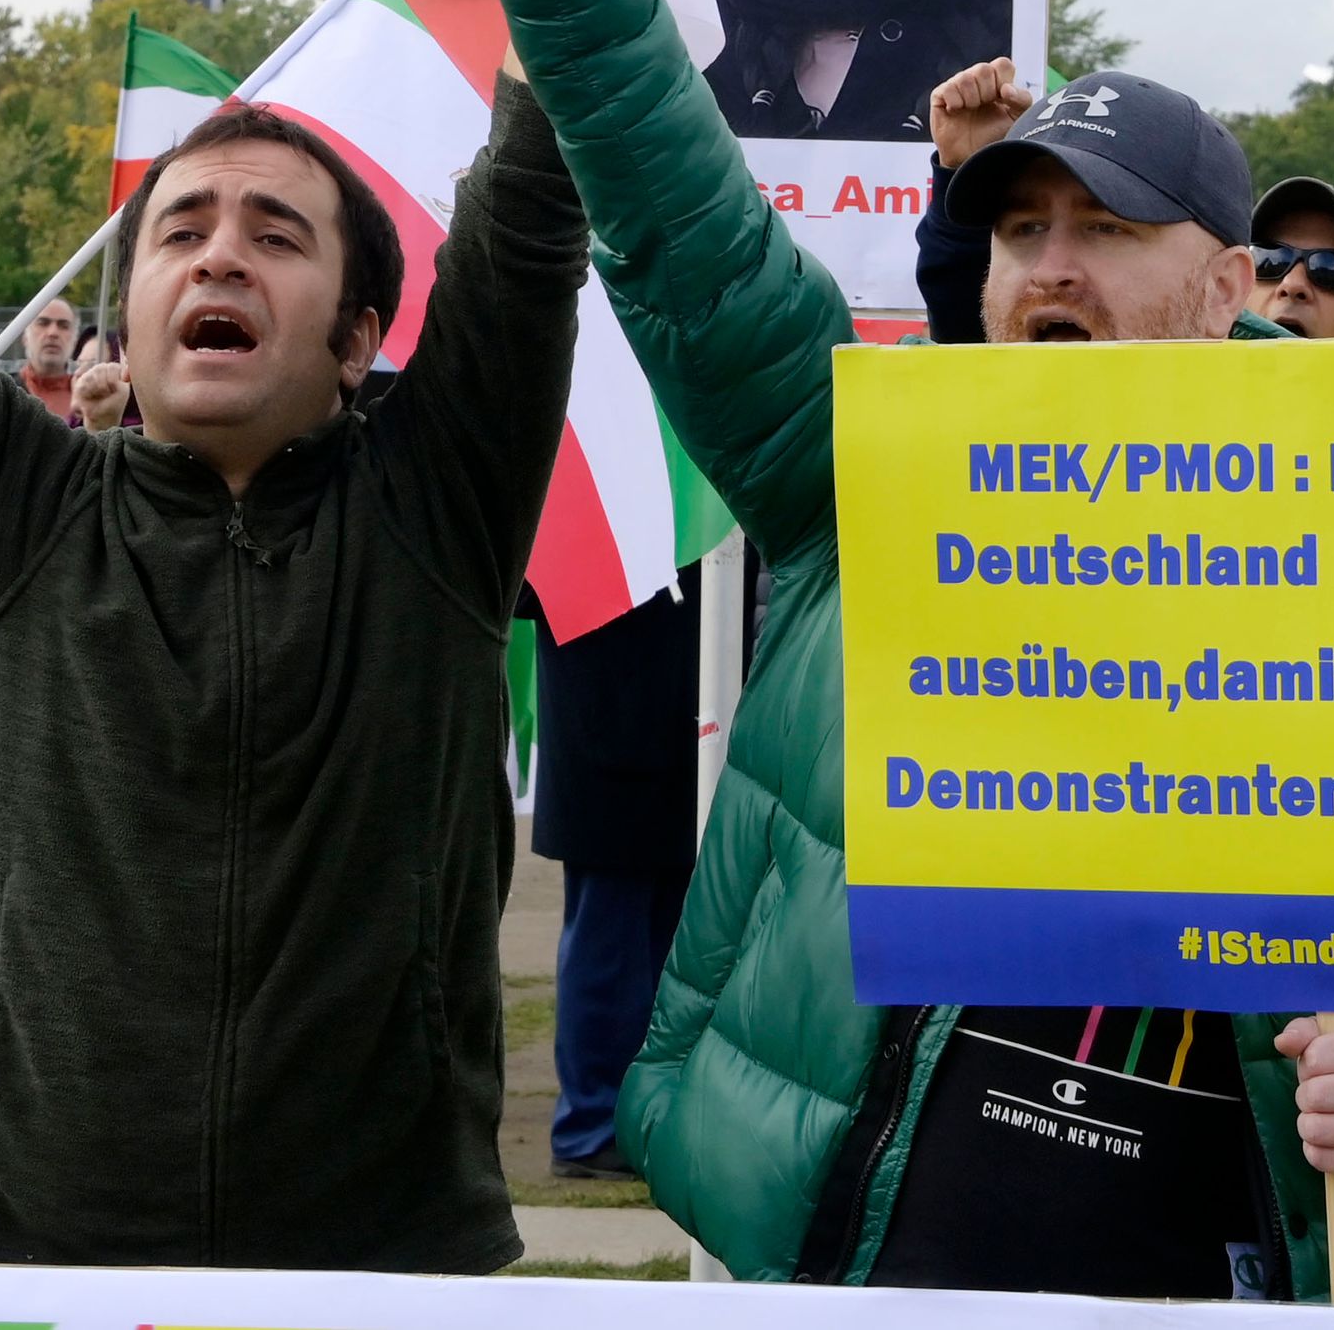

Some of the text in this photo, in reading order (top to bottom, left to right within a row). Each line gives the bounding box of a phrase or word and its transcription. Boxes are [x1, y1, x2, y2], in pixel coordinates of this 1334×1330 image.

[1020, 119, 1116, 140] UNDER ARMOUR
[969, 443, 1275, 502] MEK/PMOI
[936, 533, 1317, 586] Deutschland
[1067, 1126, 1100, 1149] NEW
[1104, 1135, 1142, 1159] YORK
